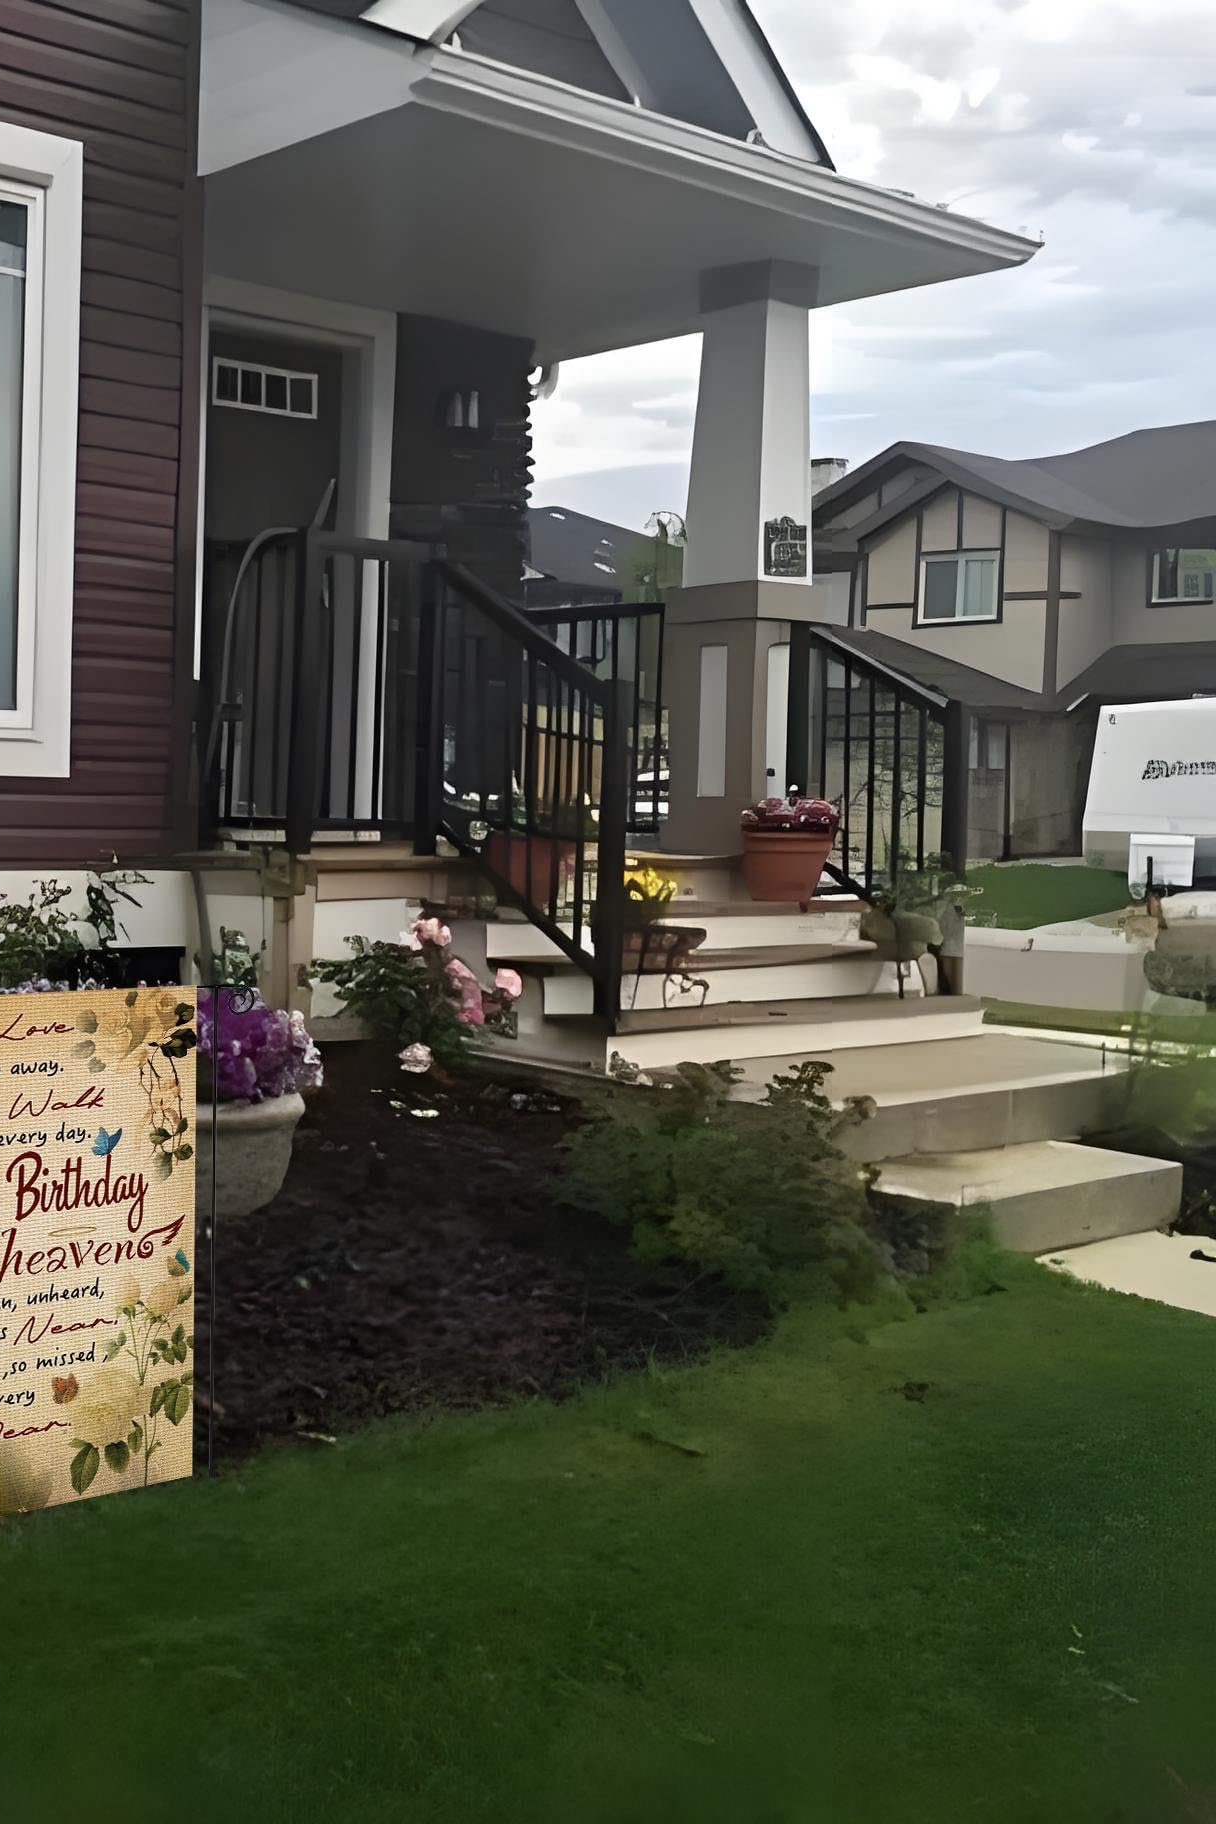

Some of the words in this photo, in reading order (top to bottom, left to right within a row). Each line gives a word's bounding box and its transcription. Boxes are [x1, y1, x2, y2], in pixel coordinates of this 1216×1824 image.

[10, 1061, 64, 1080] away.
[8, 1086, 106, 1120] Walk
[55, 1121, 92, 1144] day.
[6, 1151, 149, 1233] Birthday
[26, 1277, 105, 1306] unheard,
